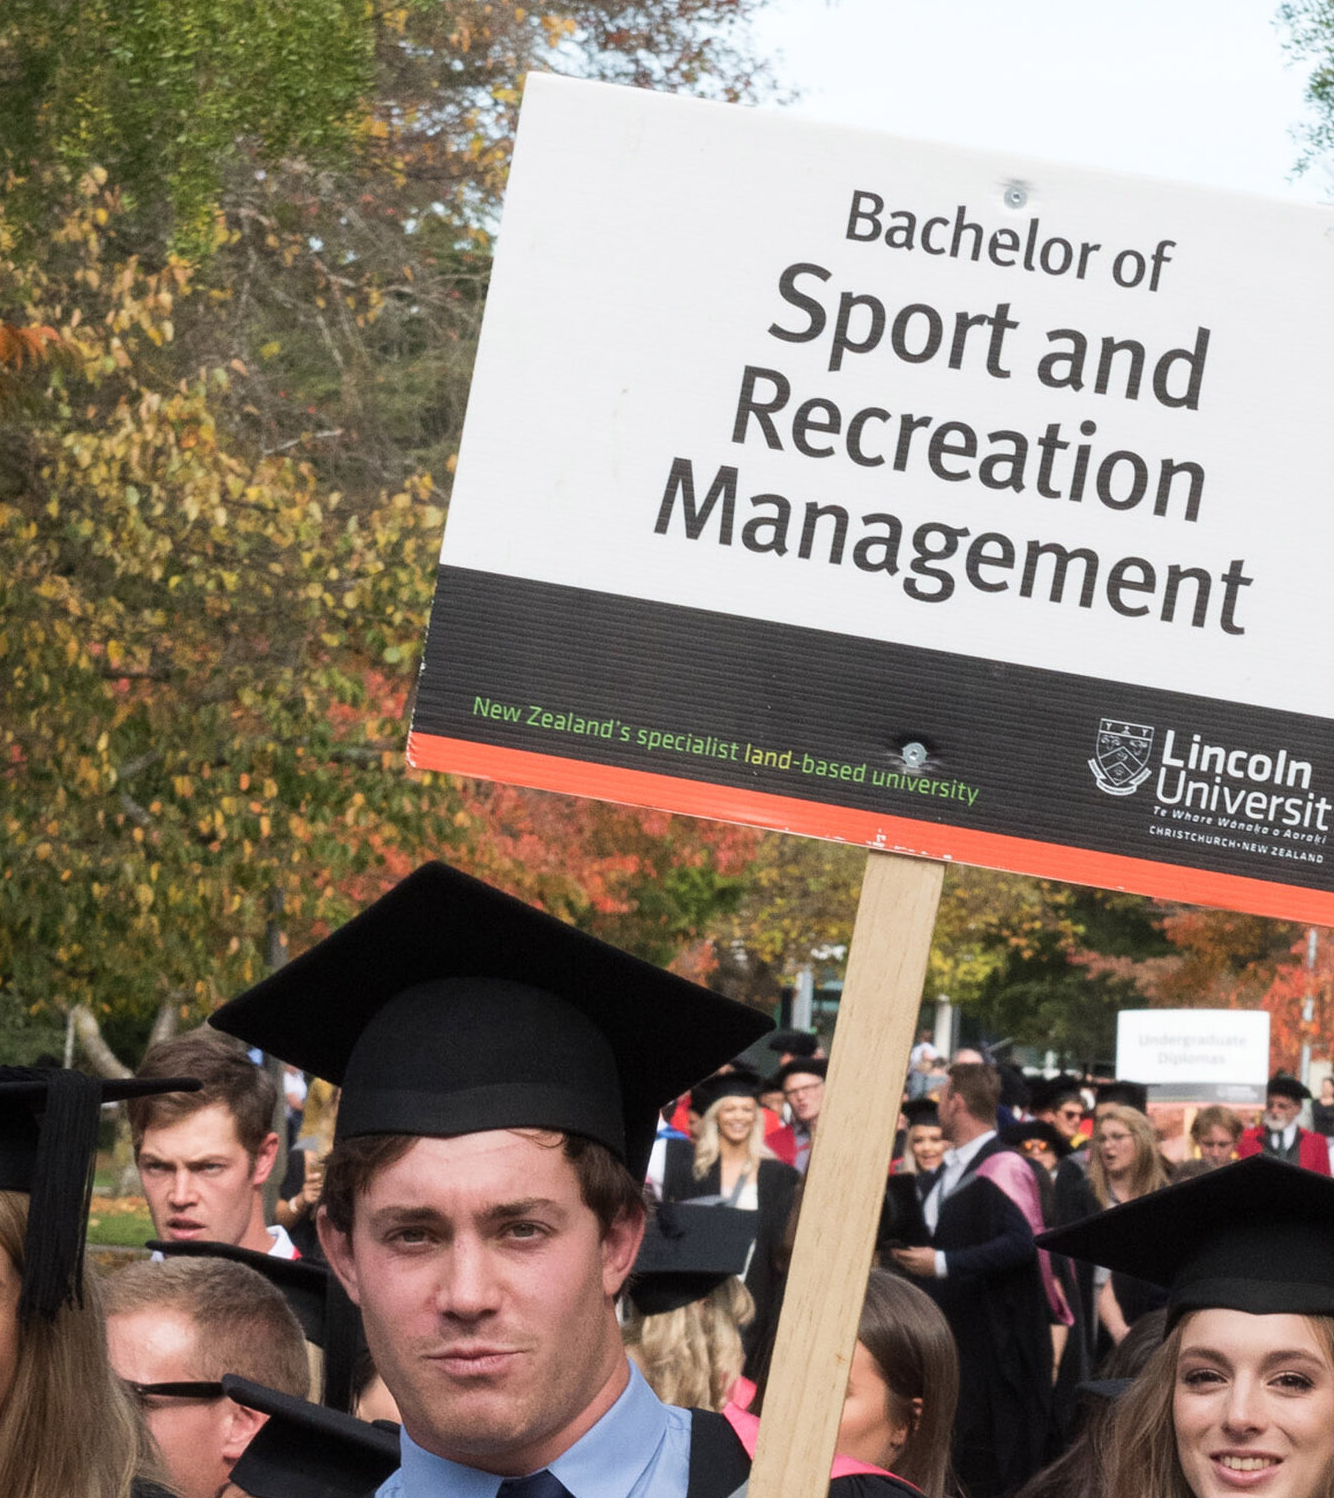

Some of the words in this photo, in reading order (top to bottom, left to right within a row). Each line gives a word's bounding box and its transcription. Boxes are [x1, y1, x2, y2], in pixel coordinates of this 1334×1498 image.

[846, 190, 1102, 280] Bachelor
[1113, 239, 1177, 292] of
[767, 262, 1020, 379] Sport
[1037, 326, 1211, 411] and
[731, 365, 1205, 523] Recreation
[654, 458, 1254, 635] Management
[473, 696, 521, 722] New
[526, 705, 631, 742] Zealand's
[637, 728, 739, 761] specialist
[745, 743, 867, 783] land-based
[872, 769, 979, 806] university
[1162, 729, 1312, 789] Lincoln
[1153, 805, 1167, 816] Te
[1172, 809, 1213, 826] Whare
[1273, 828, 1280, 836] o
[1271, 846, 1324, 864] ZEALAND
[1139, 1033, 1246, 1048] Undergraduate
[1158, 1052, 1226, 1065] Diplomas
